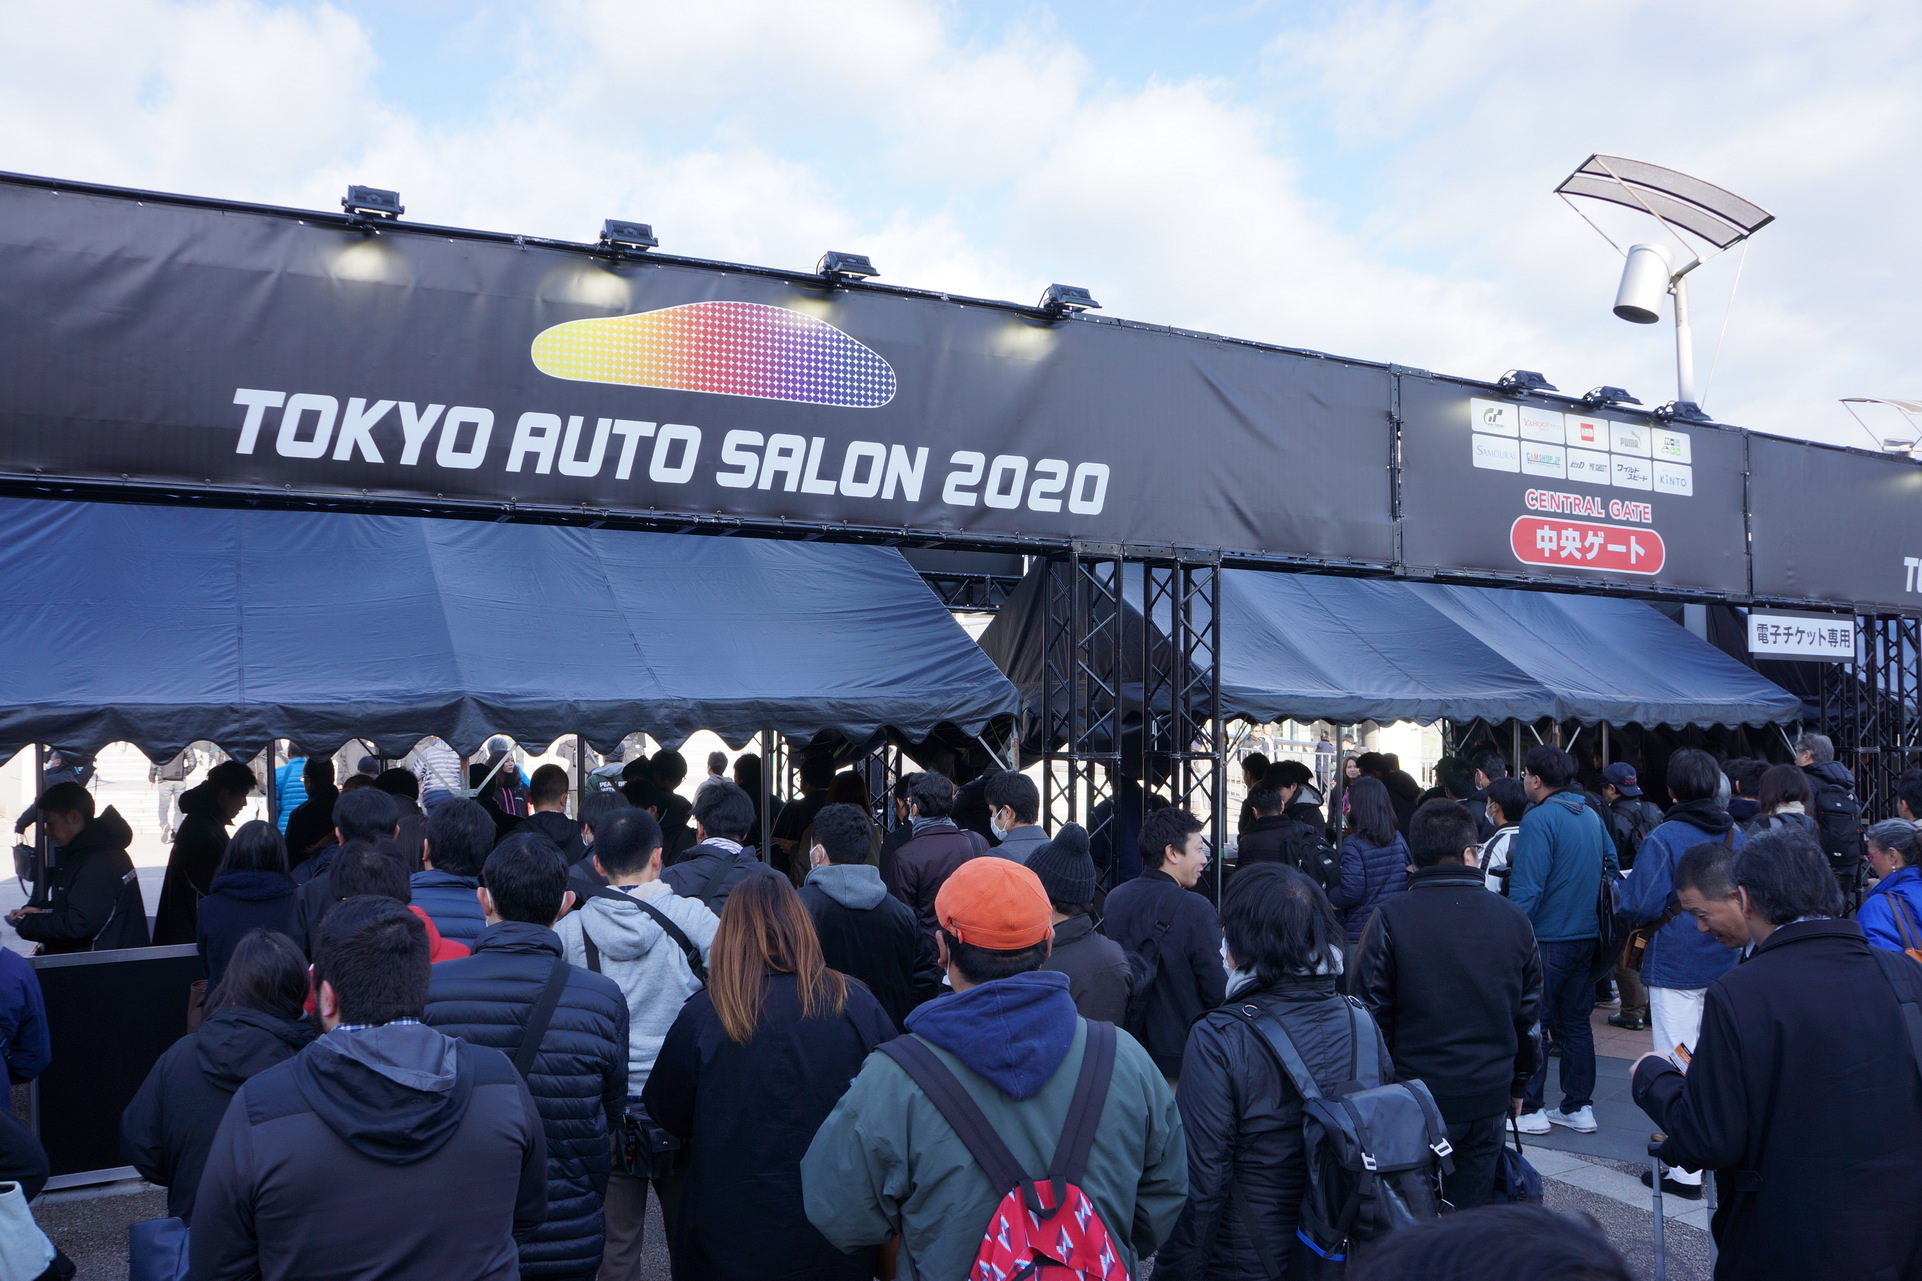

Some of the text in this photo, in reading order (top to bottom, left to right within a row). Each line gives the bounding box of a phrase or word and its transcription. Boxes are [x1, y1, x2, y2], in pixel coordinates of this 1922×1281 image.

[233, 388, 1110, 515] TOKYO AUTO SALON 2020
[1476, 445, 1516, 460] SAMOURAI
[1620, 437, 1639, 449] PUMA
[1616, 464, 1639, 474] ワイルド
[1627, 474, 1648, 482] スピード
[1525, 488, 1652, 523] CENTRAL GATE
[1536, 525, 1645, 564] 中央ゲート
[1757, 623, 1850, 648] 電子チケット専用
